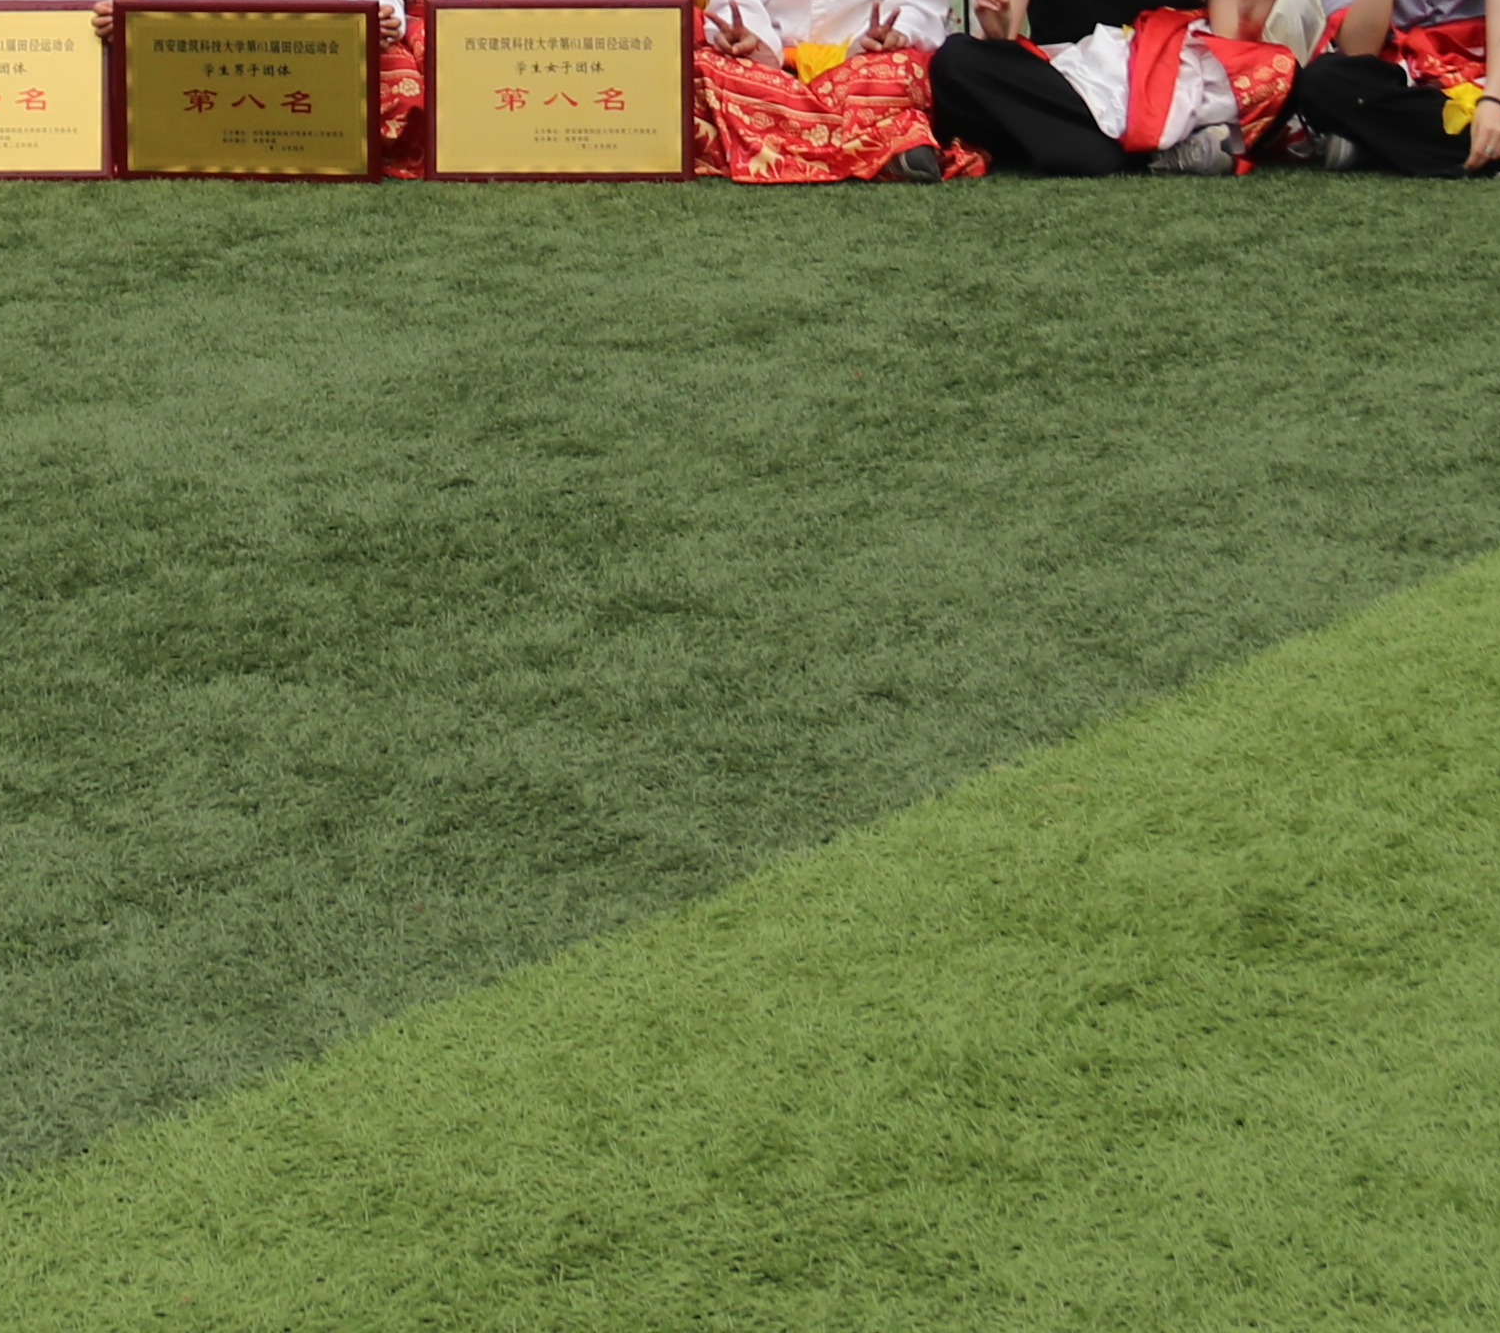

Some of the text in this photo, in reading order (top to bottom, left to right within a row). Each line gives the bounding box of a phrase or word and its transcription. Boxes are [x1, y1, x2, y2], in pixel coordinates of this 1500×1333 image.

[203, 63, 292, 77] 学生男子团体
[514, 60, 605, 75] 学生女子团体
[182, 88, 313, 114] 第八名
[494, 86, 626, 112] 第八名
